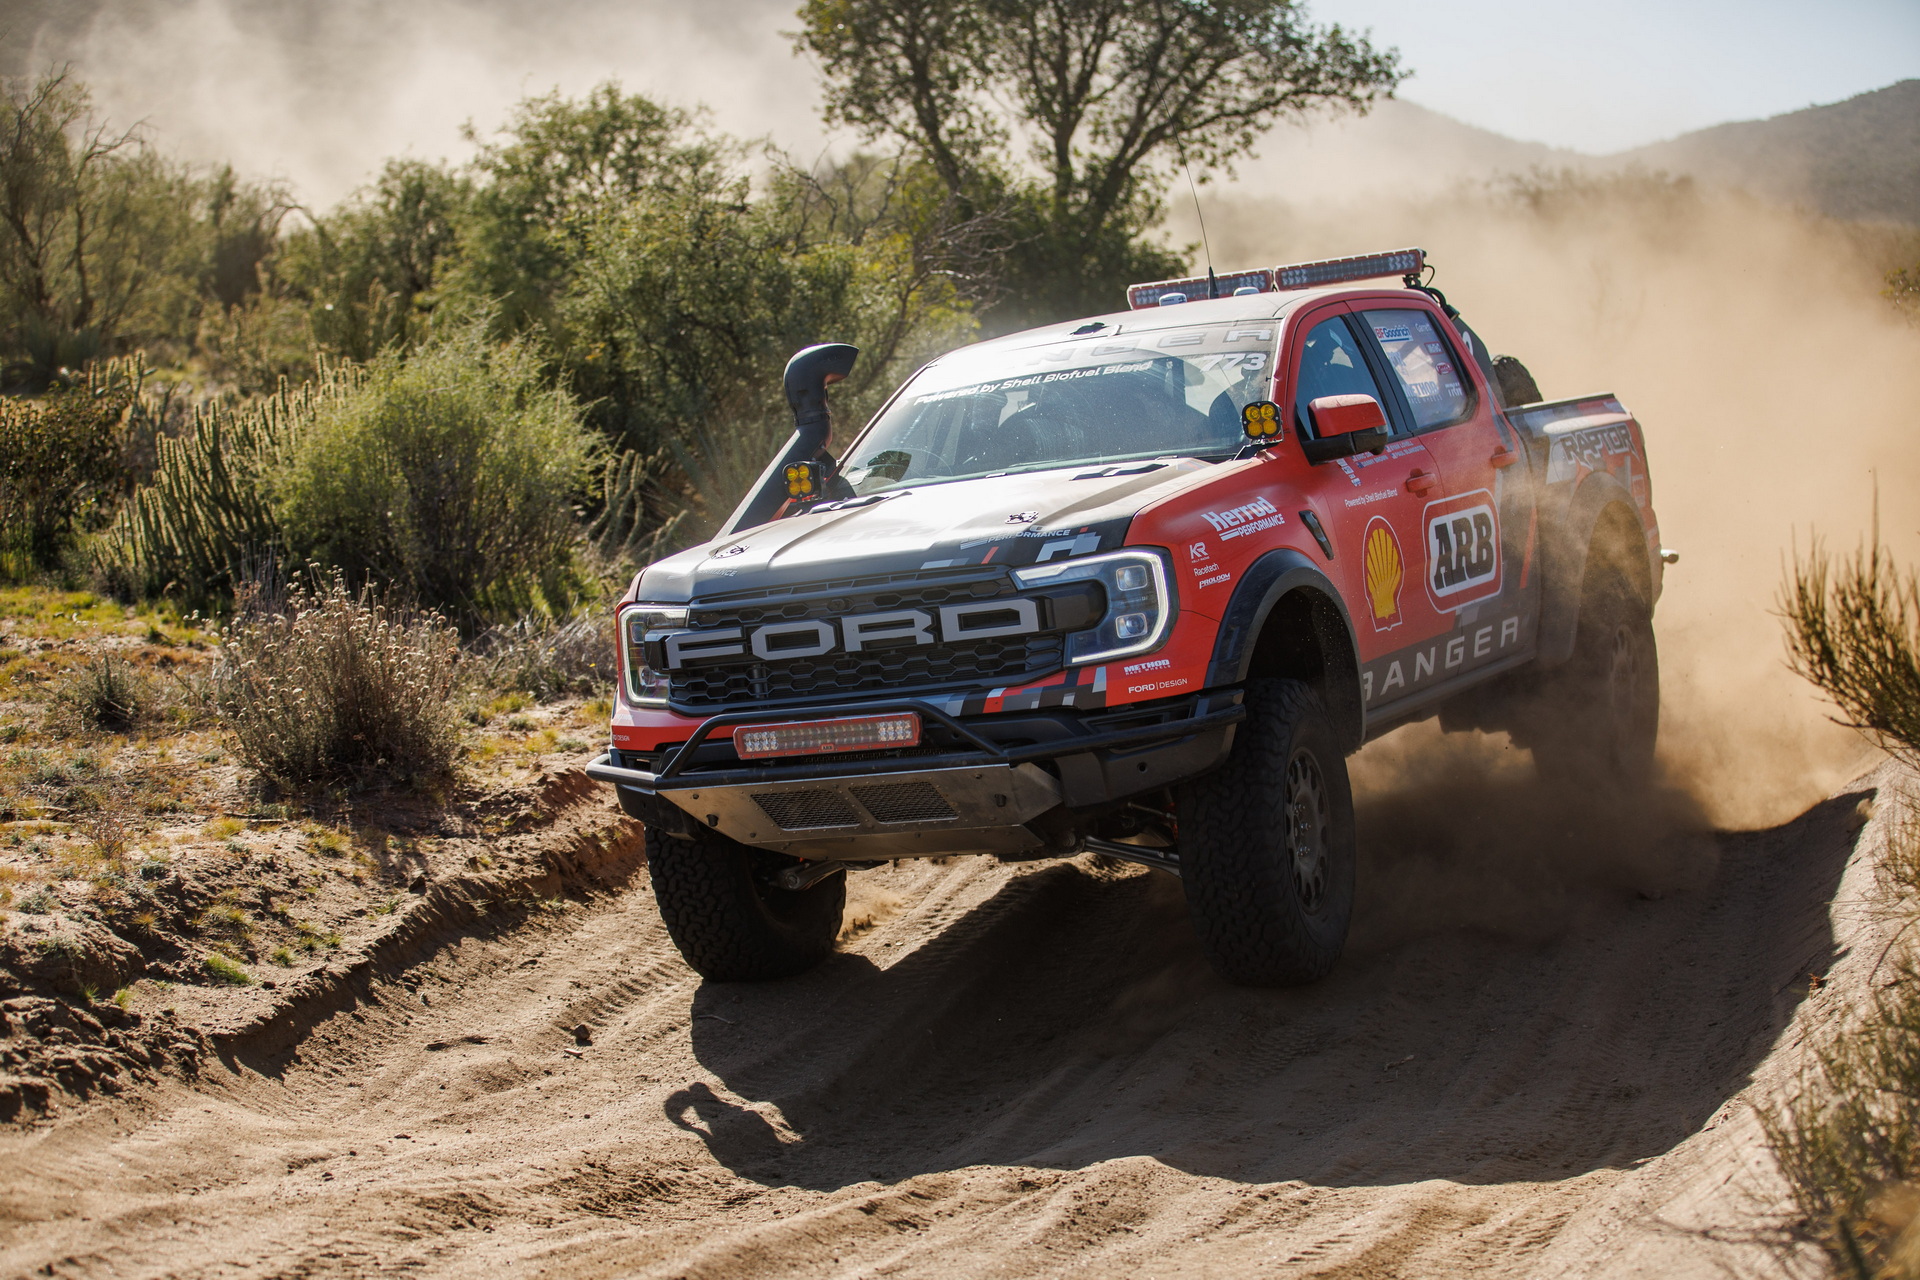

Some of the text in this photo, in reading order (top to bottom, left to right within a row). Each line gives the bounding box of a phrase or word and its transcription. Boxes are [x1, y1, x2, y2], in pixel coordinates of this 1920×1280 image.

[1375, 326, 1410, 339] BFGoodrich
[1200, 353, 1267, 373] 773
[913, 360, 1154, 406] Powered by Shell Biofuel Blend
[1558, 423, 1640, 472] RAPTOR
[1200, 496, 1278, 532] Herrod
[1238, 513, 1286, 537] PERFORMANCE
[1189, 542, 1208, 559] KR
[1433, 512, 1495, 591] ARB
[1193, 563, 1220, 577] Racetech
[665, 599, 1040, 670] FORD
[1124, 659, 1170, 673] METHOD
[1128, 678, 1188, 694] FORD DESIGN
